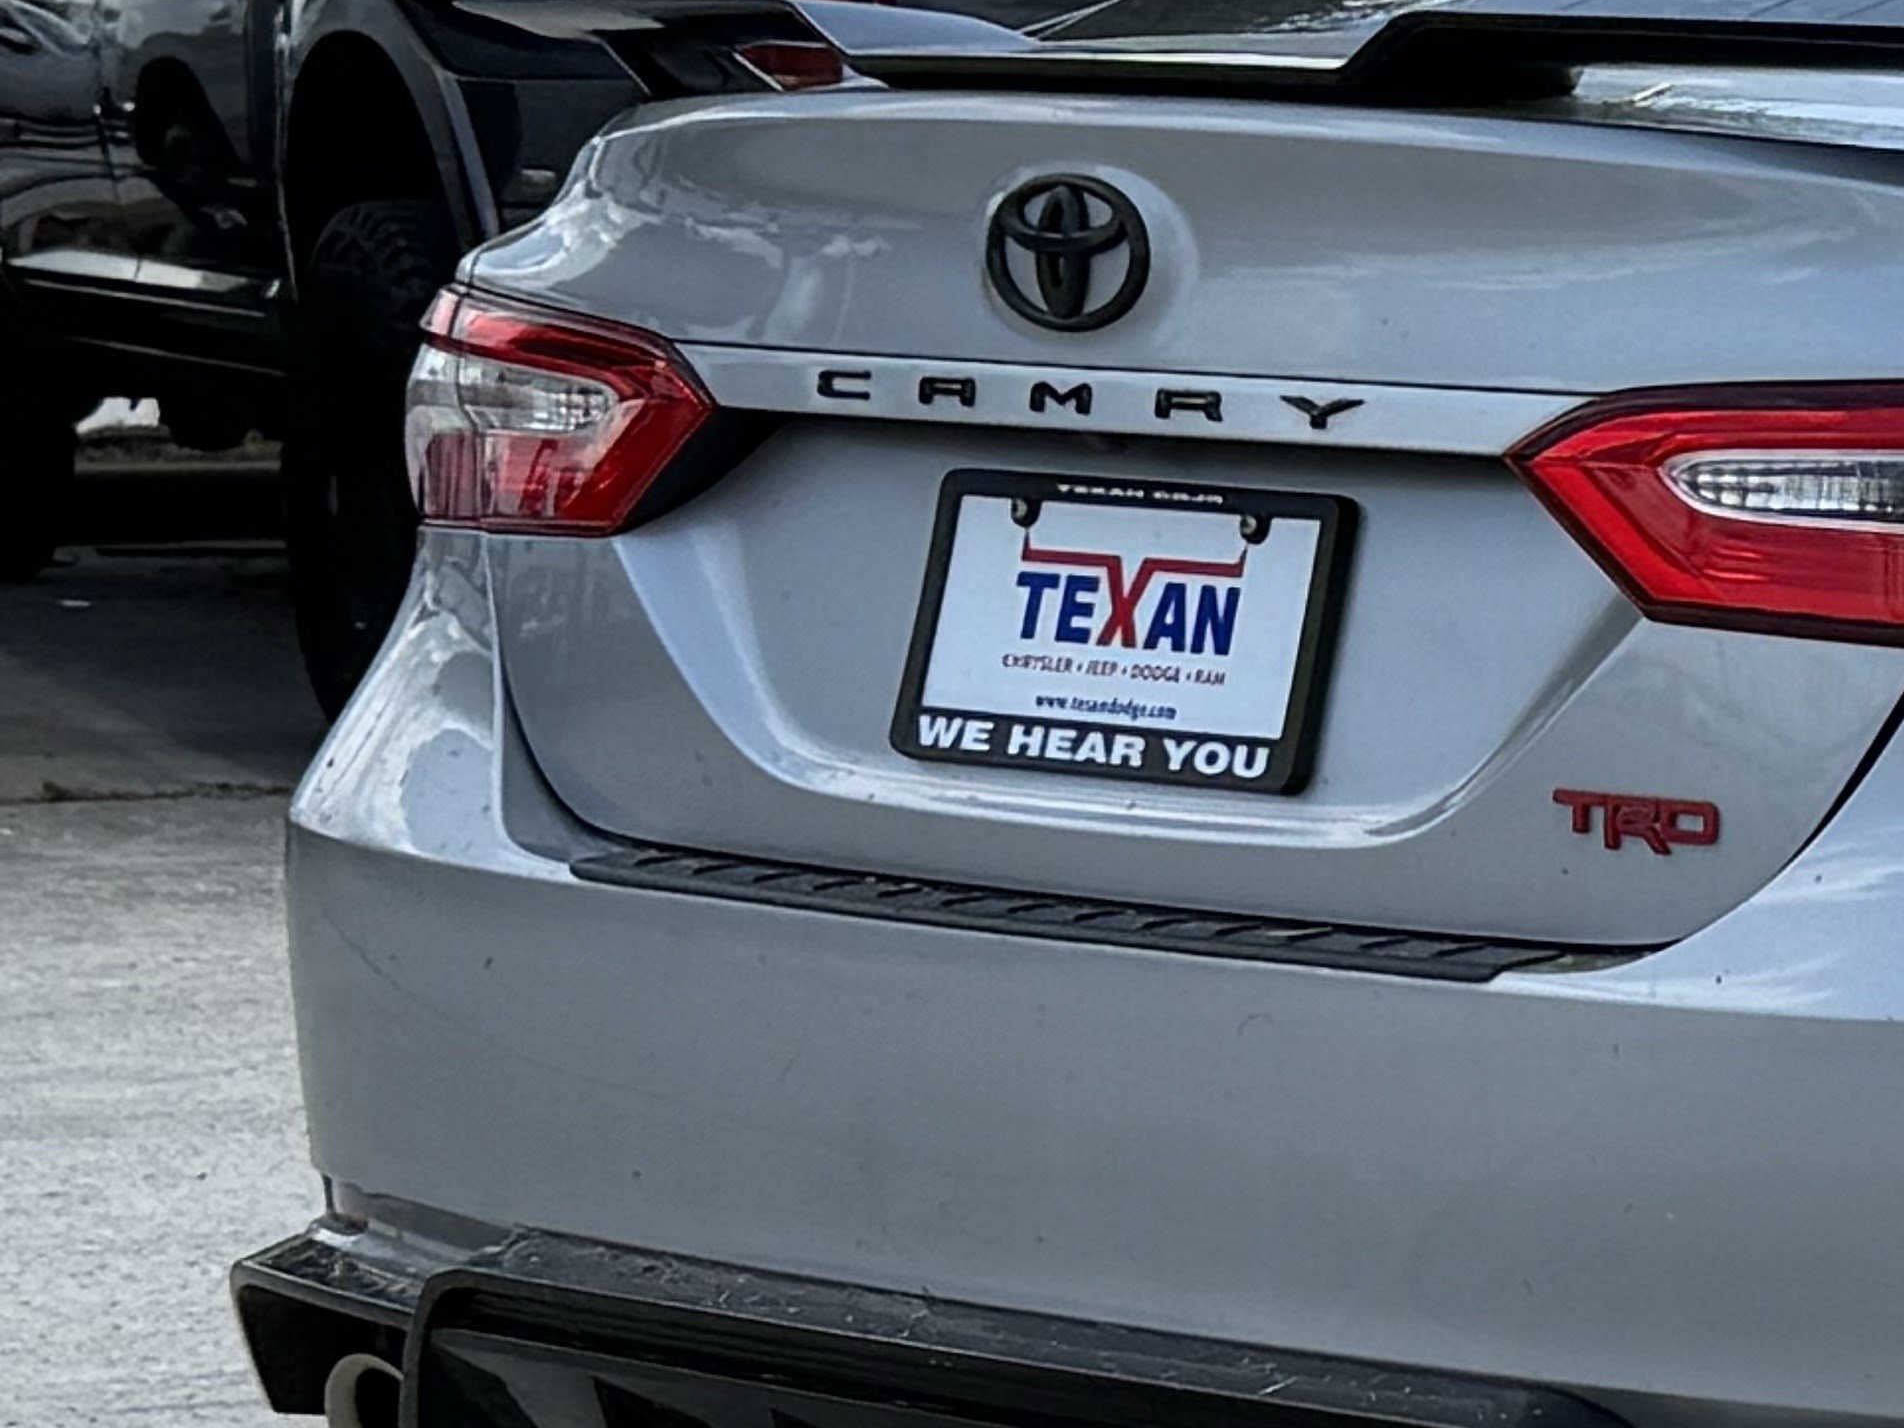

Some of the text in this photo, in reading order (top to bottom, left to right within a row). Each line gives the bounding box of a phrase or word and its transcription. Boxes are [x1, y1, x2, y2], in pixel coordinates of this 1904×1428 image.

[816, 368, 1366, 430] CAMRY
[1016, 554, 1242, 657] TEXAN
[1001, 652, 1072, 673] CHRYSLER
[1084, 659, 1119, 678] JEEP
[1194, 669, 1226, 686] RAM
[917, 713, 1271, 779] WE HEAR YOU
[1552, 787, 1720, 856] TRD
